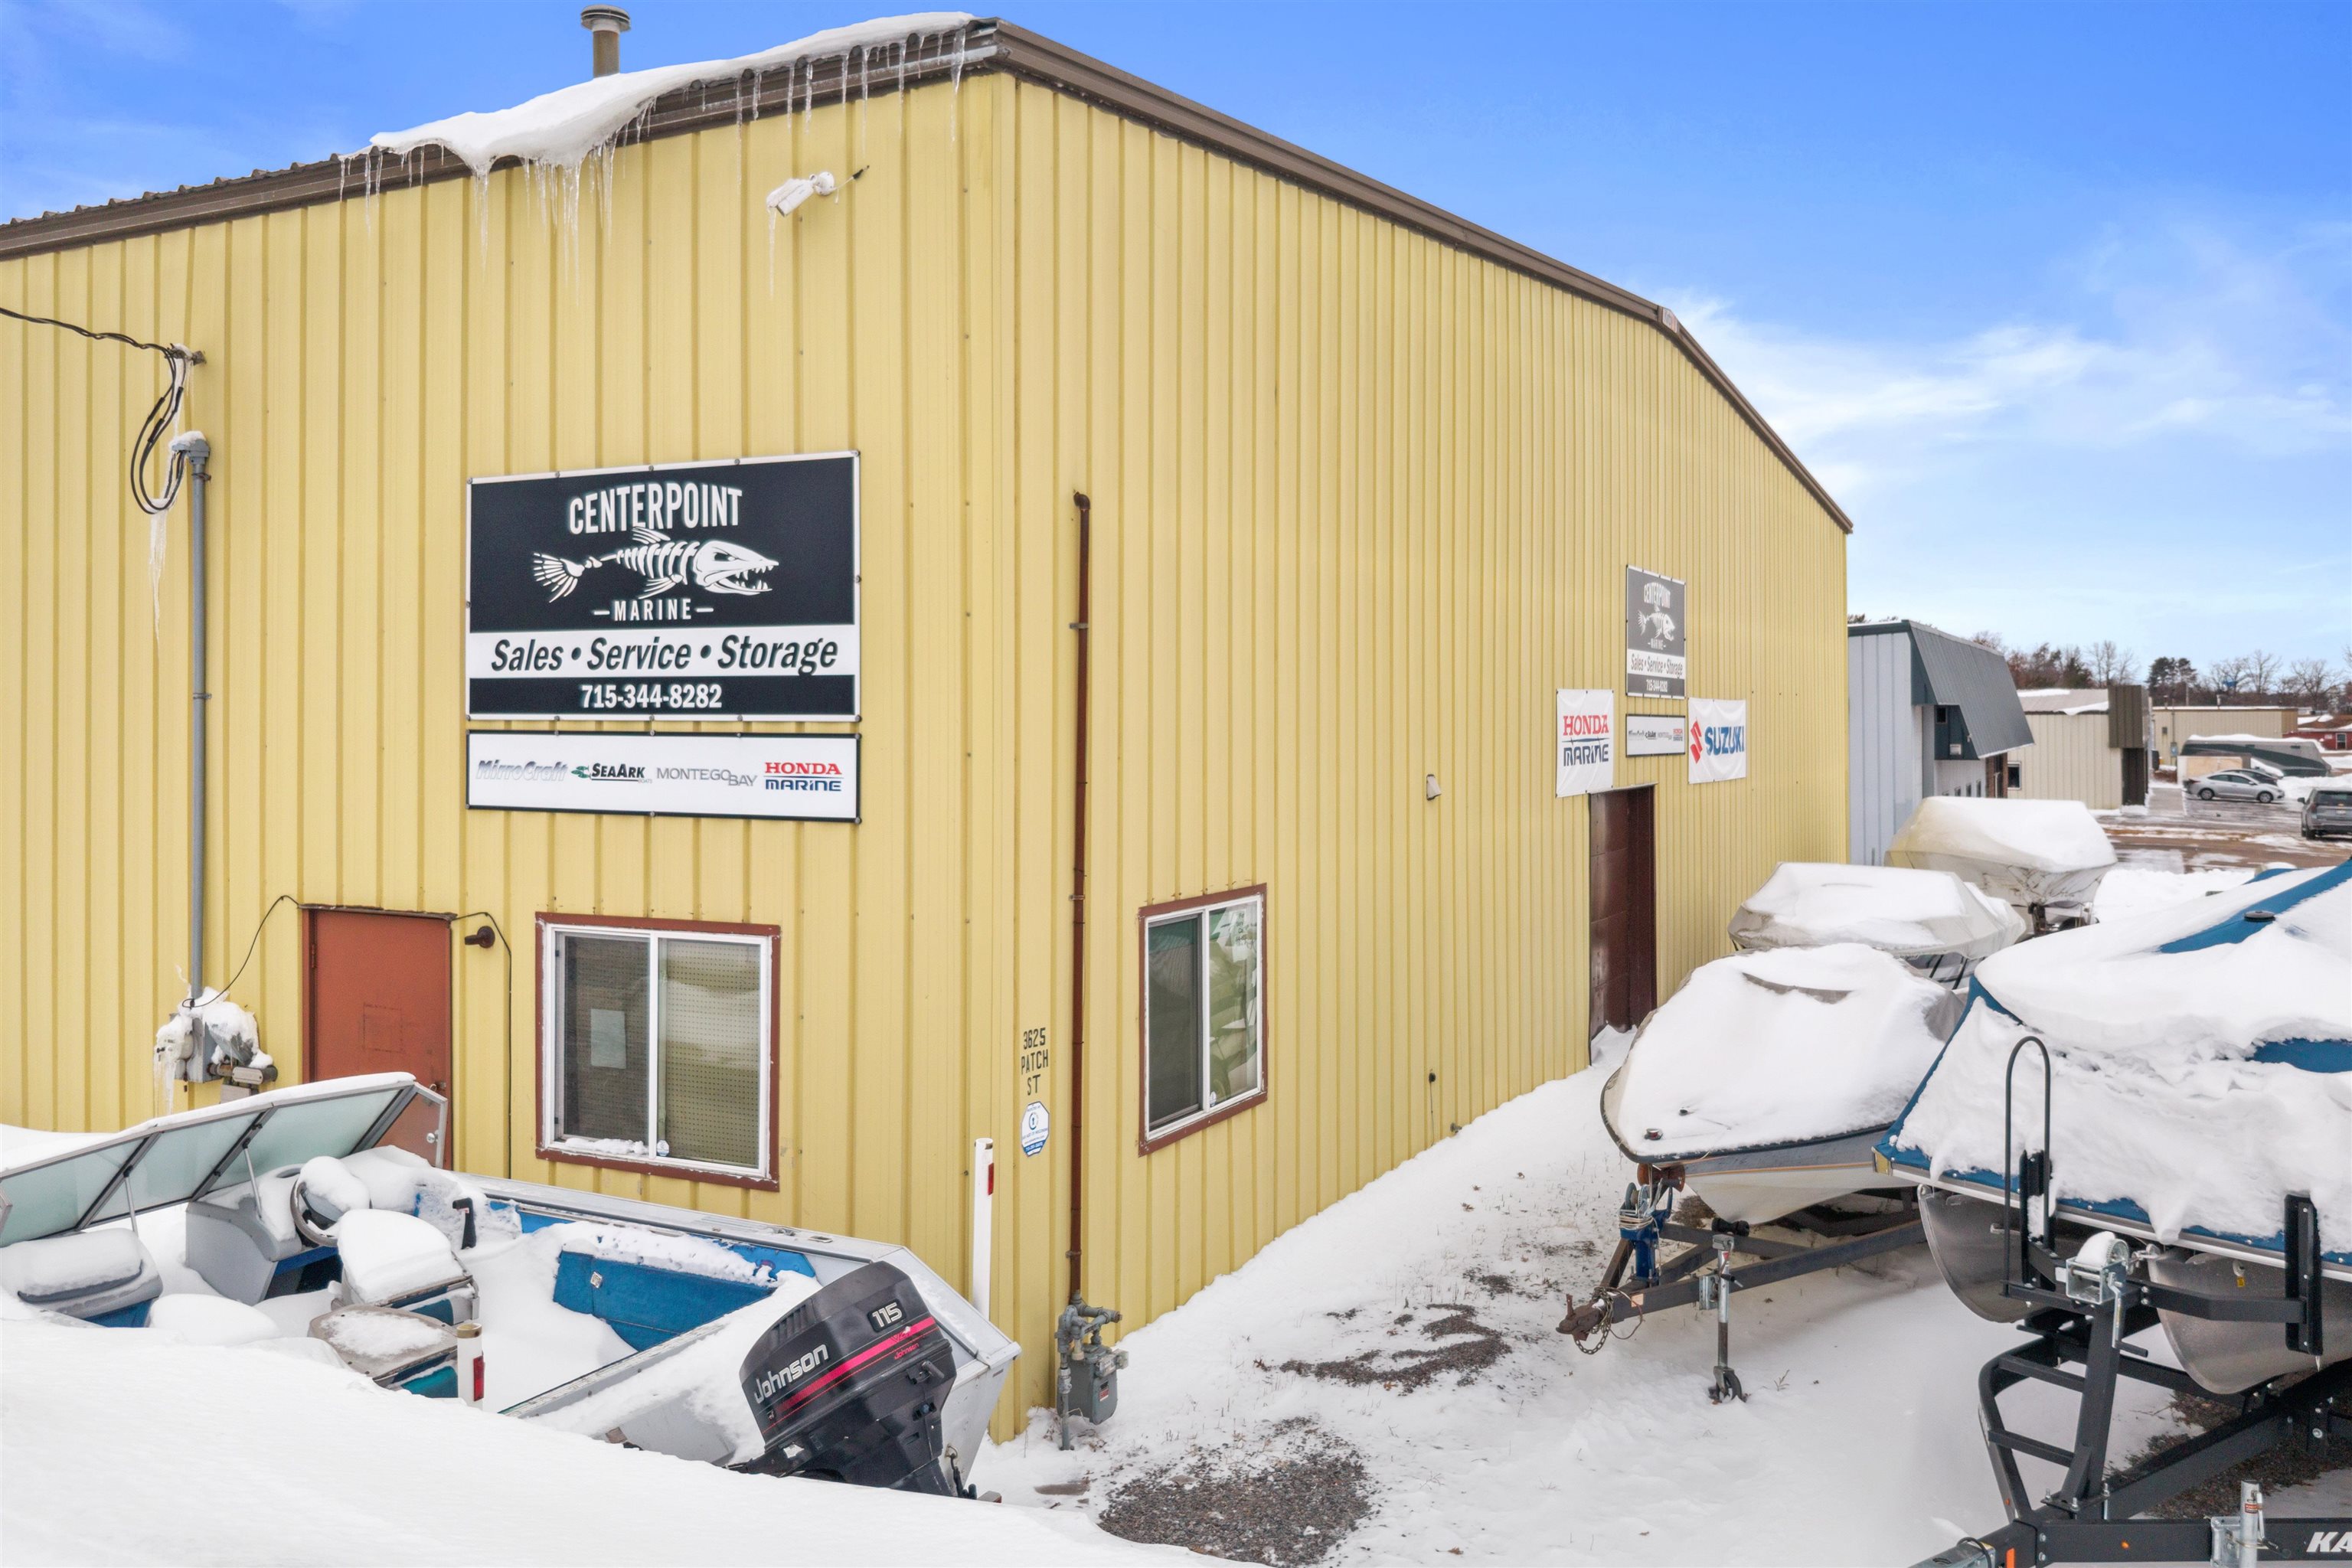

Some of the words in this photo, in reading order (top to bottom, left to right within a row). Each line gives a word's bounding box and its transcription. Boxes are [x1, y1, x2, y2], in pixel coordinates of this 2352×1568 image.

[569, 482, 743, 534] CENTERPOINT
[613, 599, 692, 621] MARINE
[491, 639, 564, 671] Sales
[586, 636, 691, 671] Service
[717, 634, 839, 675] Storage
[1631, 653, 1644, 671] Sales
[1647, 655, 1663, 674] Service
[1666, 658, 1683, 679] Storage
[580, 684, 722, 708] 715-344-8282
[1563, 714, 1609, 736] HONDA
[1704, 726, 1745, 756] SUZUKI
[475, 760, 568, 782] MirroCraft
[765, 762, 843, 775] HONDA
[1023, 1027, 1046, 1050] 3625
[1021, 1049, 1049, 1074] PATCH
[1027, 1074, 1041, 1096] ST
[871, 1302, 903, 1328] 115
[893, 1342, 920, 1360] Johnson
[753, 1344, 829, 1404] Johnson
